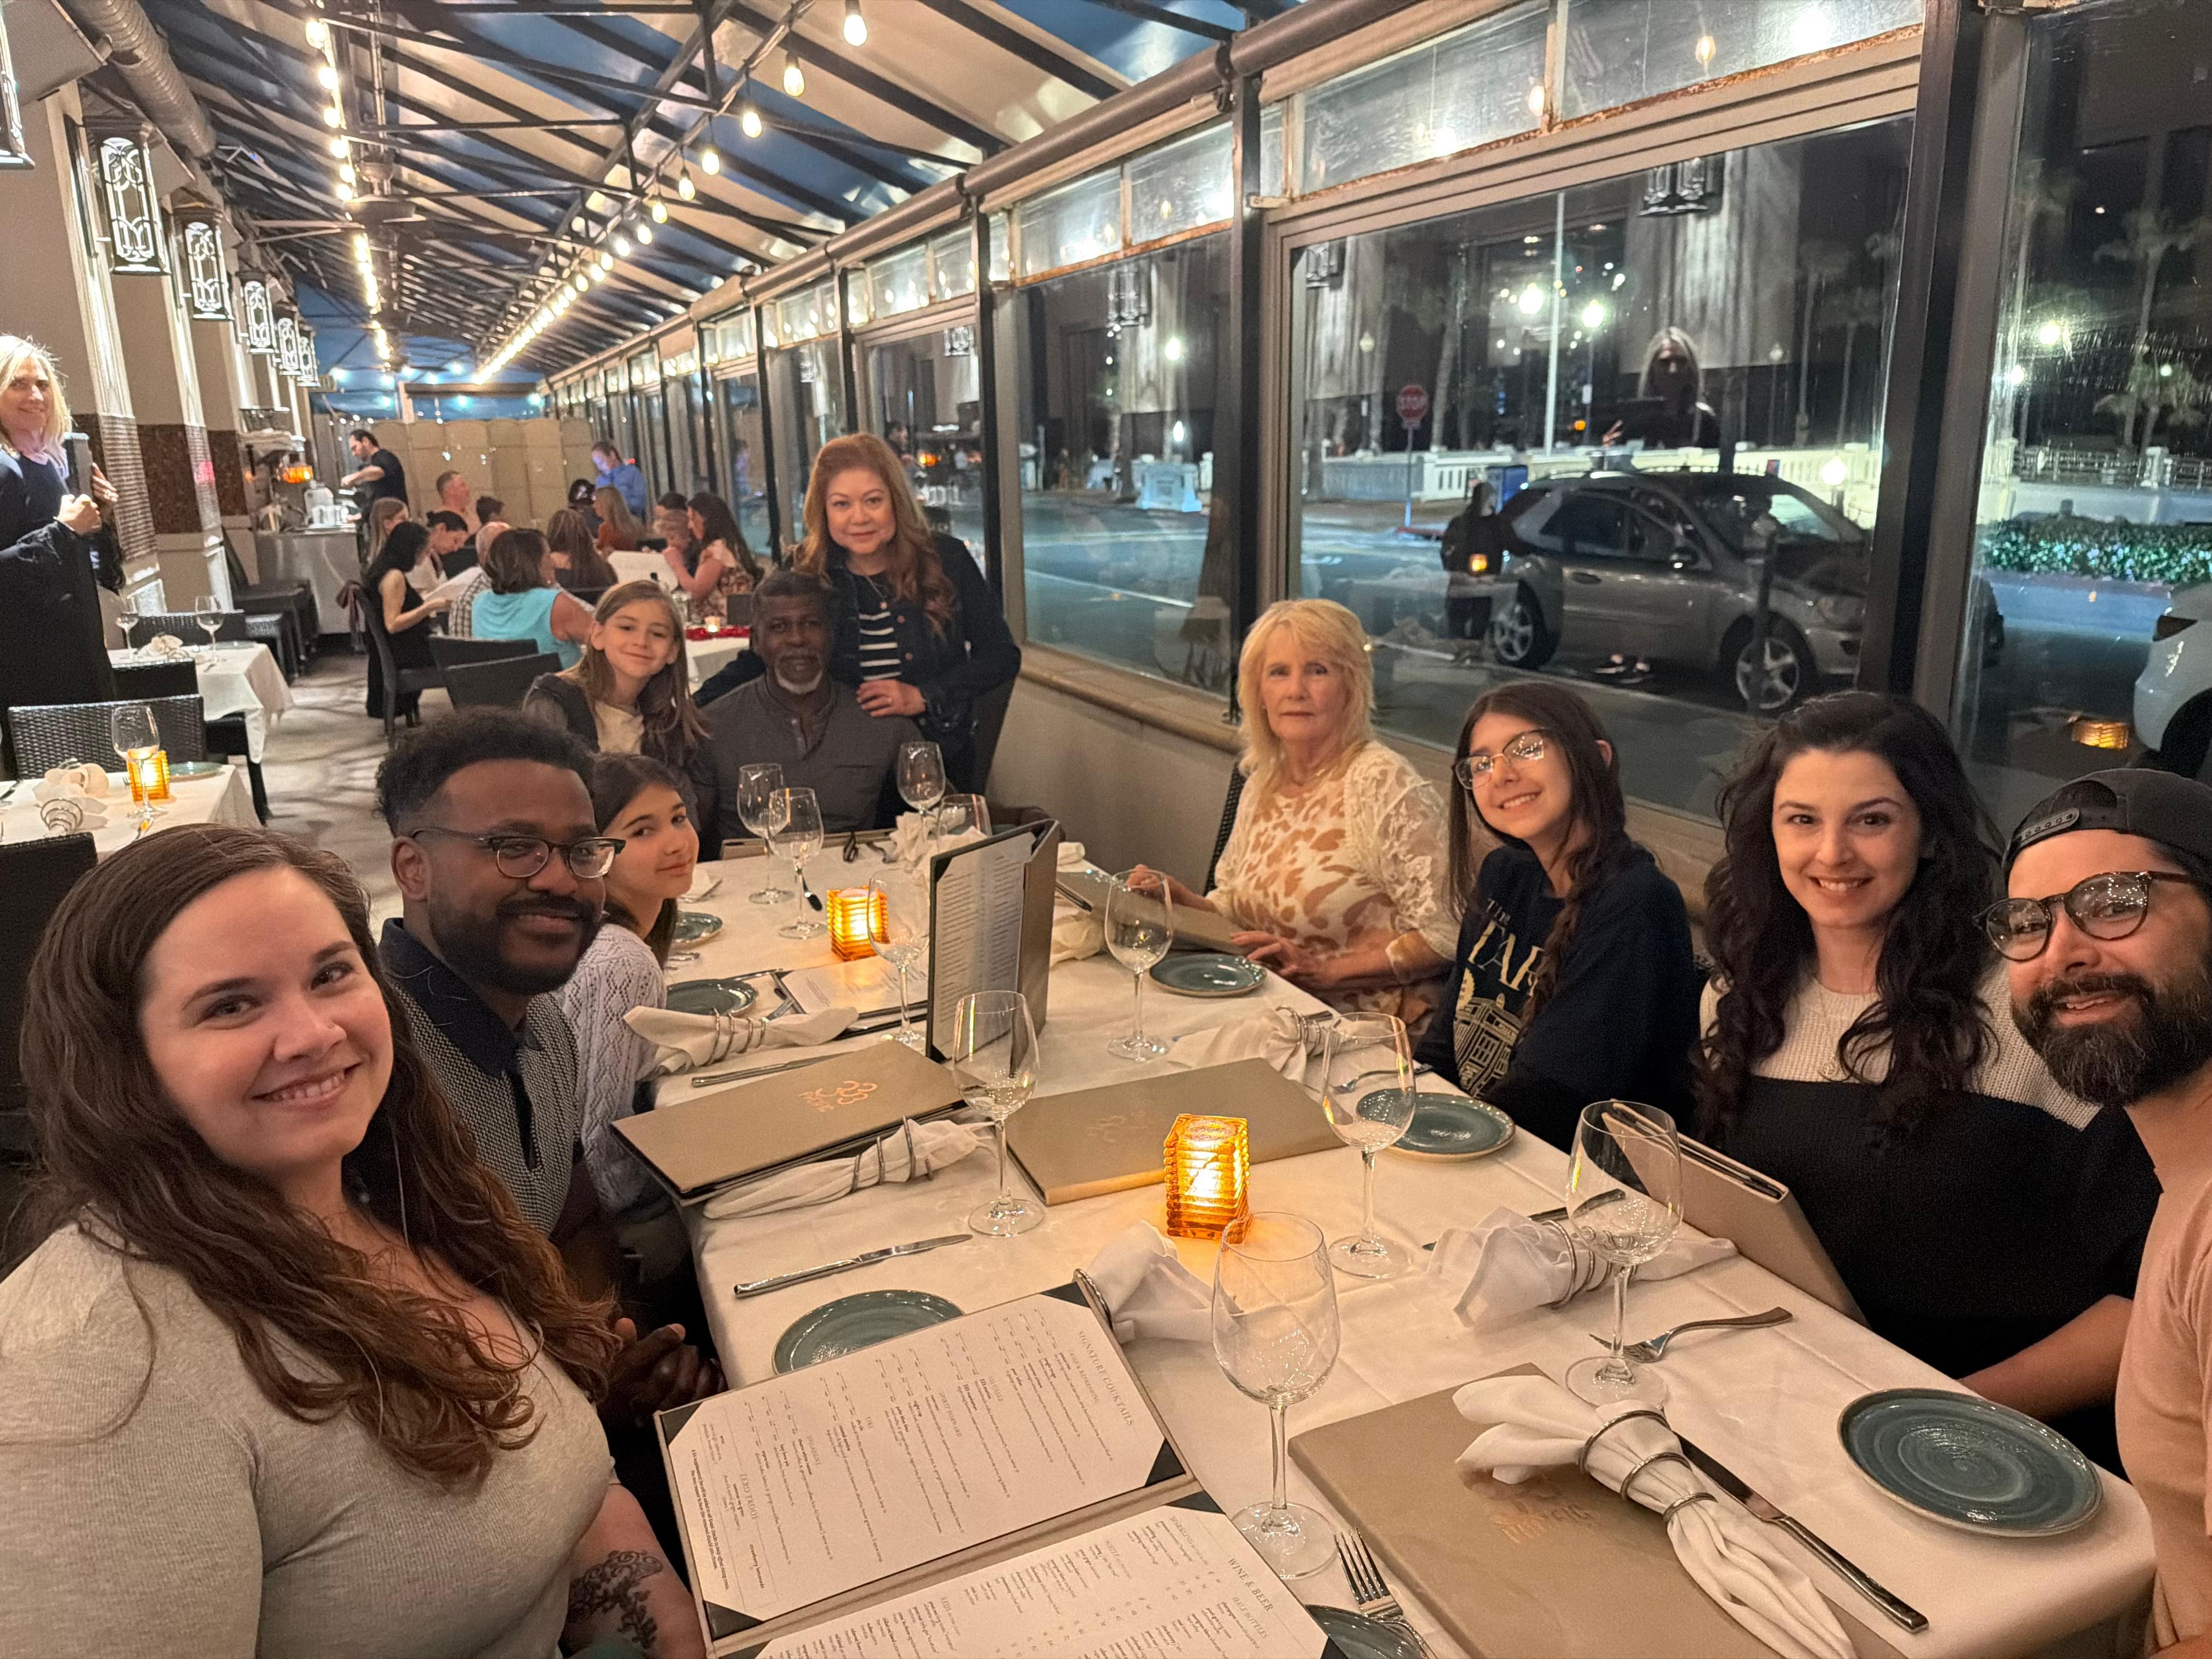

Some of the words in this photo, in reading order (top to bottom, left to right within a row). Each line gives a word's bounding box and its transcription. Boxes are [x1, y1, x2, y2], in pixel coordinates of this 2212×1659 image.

[1076, 1330, 1107, 1375] SIGNATURE
[1102, 1376, 1136, 1426] COCKTAILS
[747, 1543, 760, 1567] strawberry
[755, 1566, 766, 1589] lemonade
[1226, 1558, 1251, 1580] WINE
[1250, 1588, 1276, 1611] BEER
[938, 1596, 953, 1612] REDS
[1242, 1611, 1271, 1639] BOTTLES
